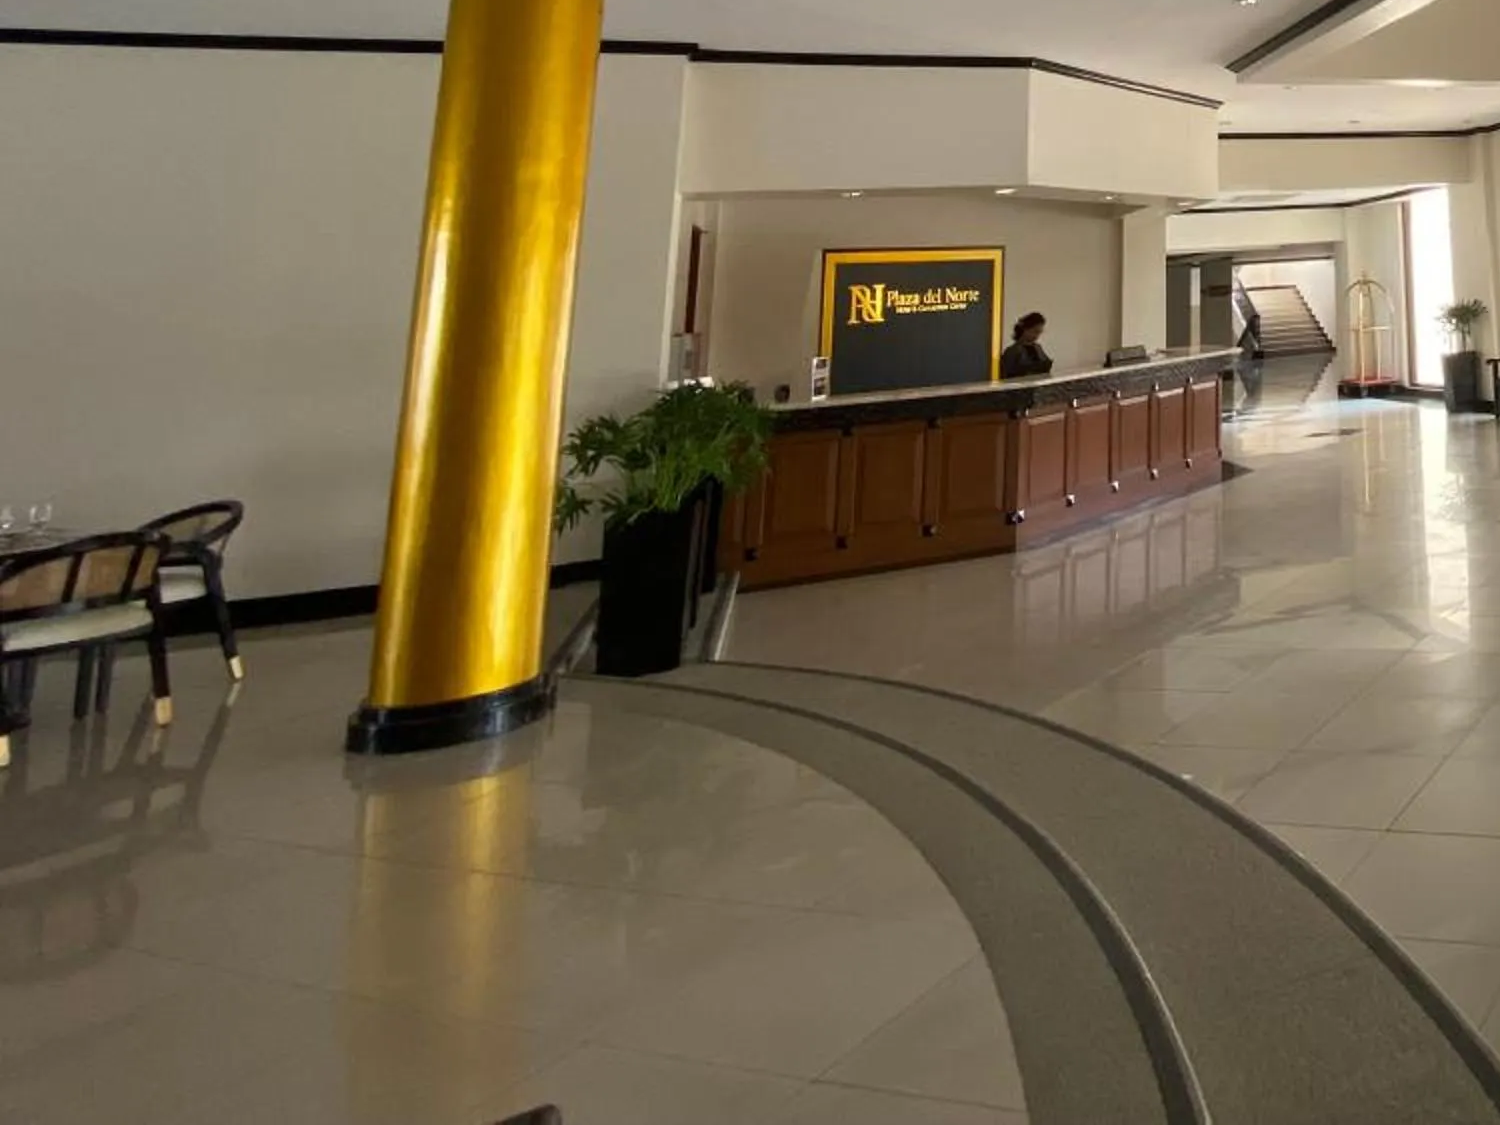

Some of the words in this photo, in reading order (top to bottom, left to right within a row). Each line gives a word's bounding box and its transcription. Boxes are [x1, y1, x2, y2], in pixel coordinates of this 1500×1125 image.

[886, 289, 920, 307] Plaza
[923, 288, 941, 304] del
[945, 286, 980, 303] Norte
